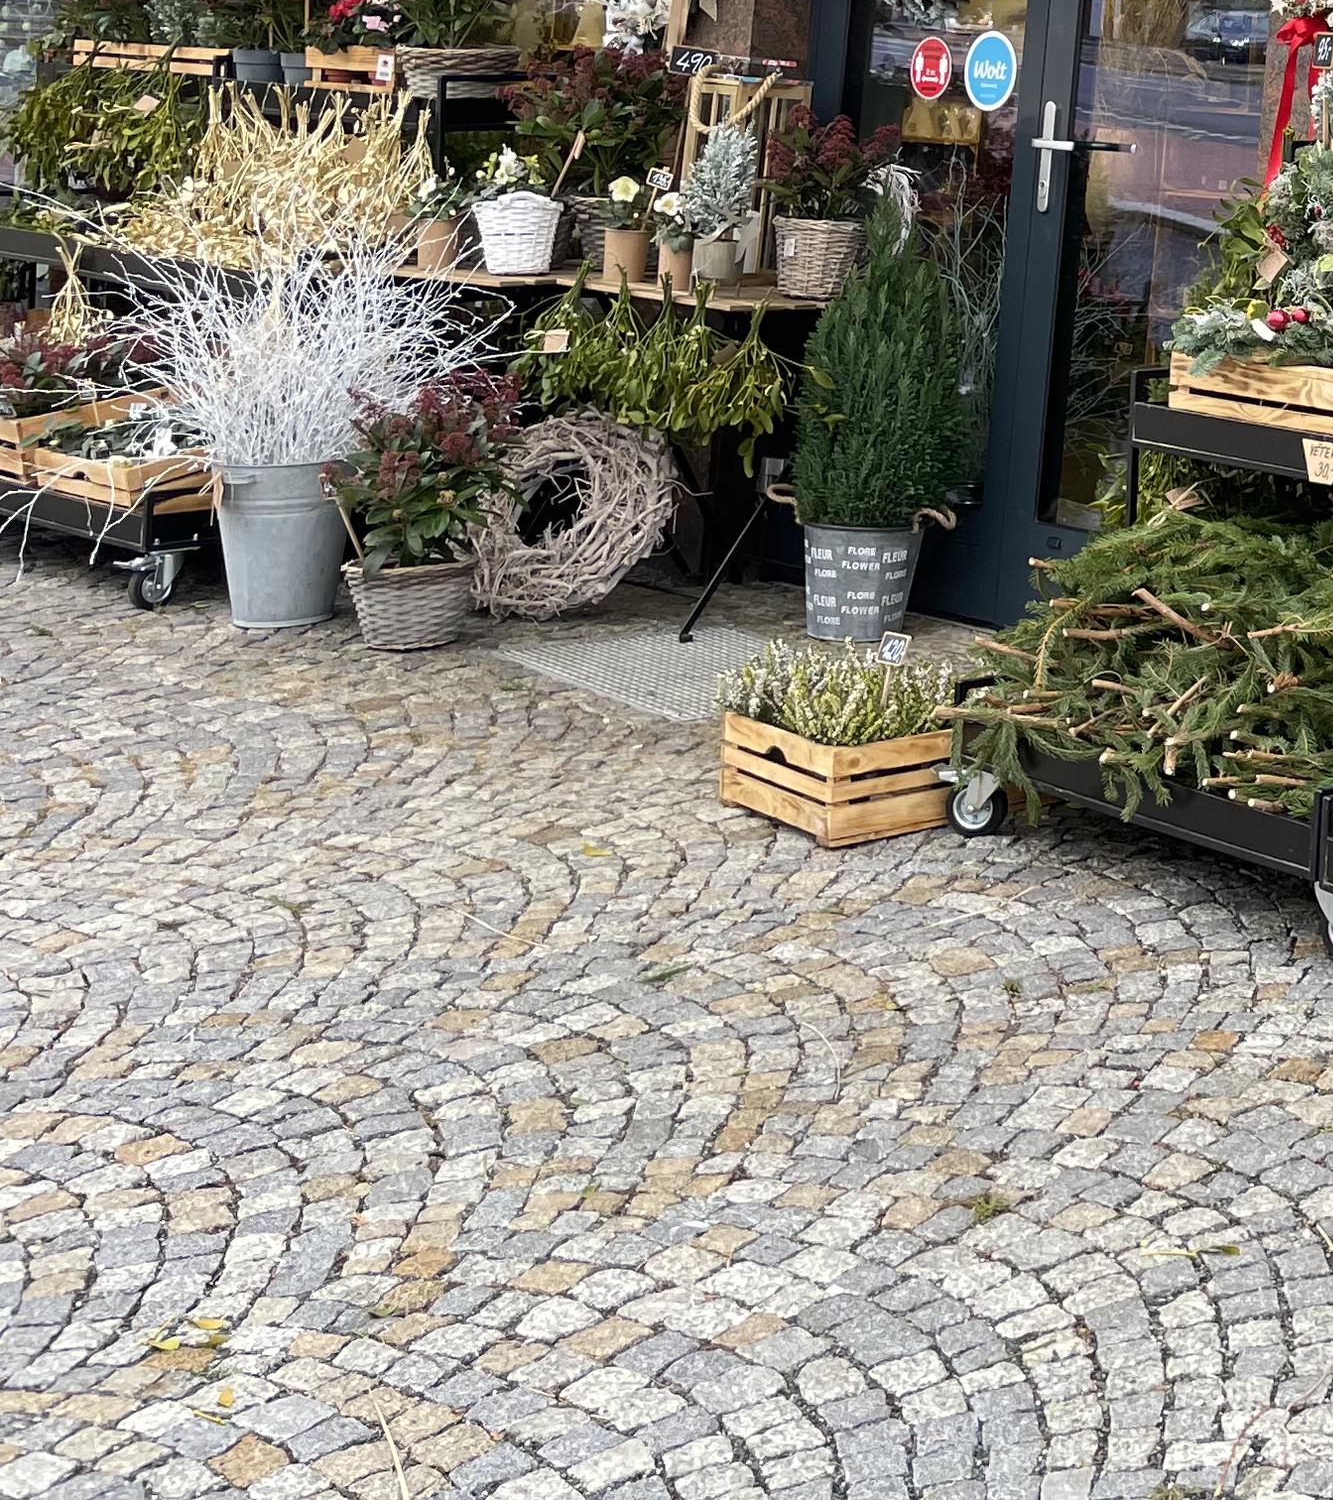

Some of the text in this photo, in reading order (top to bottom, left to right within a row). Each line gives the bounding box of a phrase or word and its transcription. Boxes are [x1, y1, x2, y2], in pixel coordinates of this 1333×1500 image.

[973, 60, 1008, 80] Wolt
[811, 547, 833, 561] FLEUR
[847, 546, 877, 557] FLORE
[882, 550, 908, 565] FLEUR
[842, 560, 880, 571] FLOWER
[814, 568, 837, 579] FLORE
[813, 594, 837, 608] FLEUR
[847, 591, 876, 600] FLORE
[841, 605, 880, 615] FLOWER
